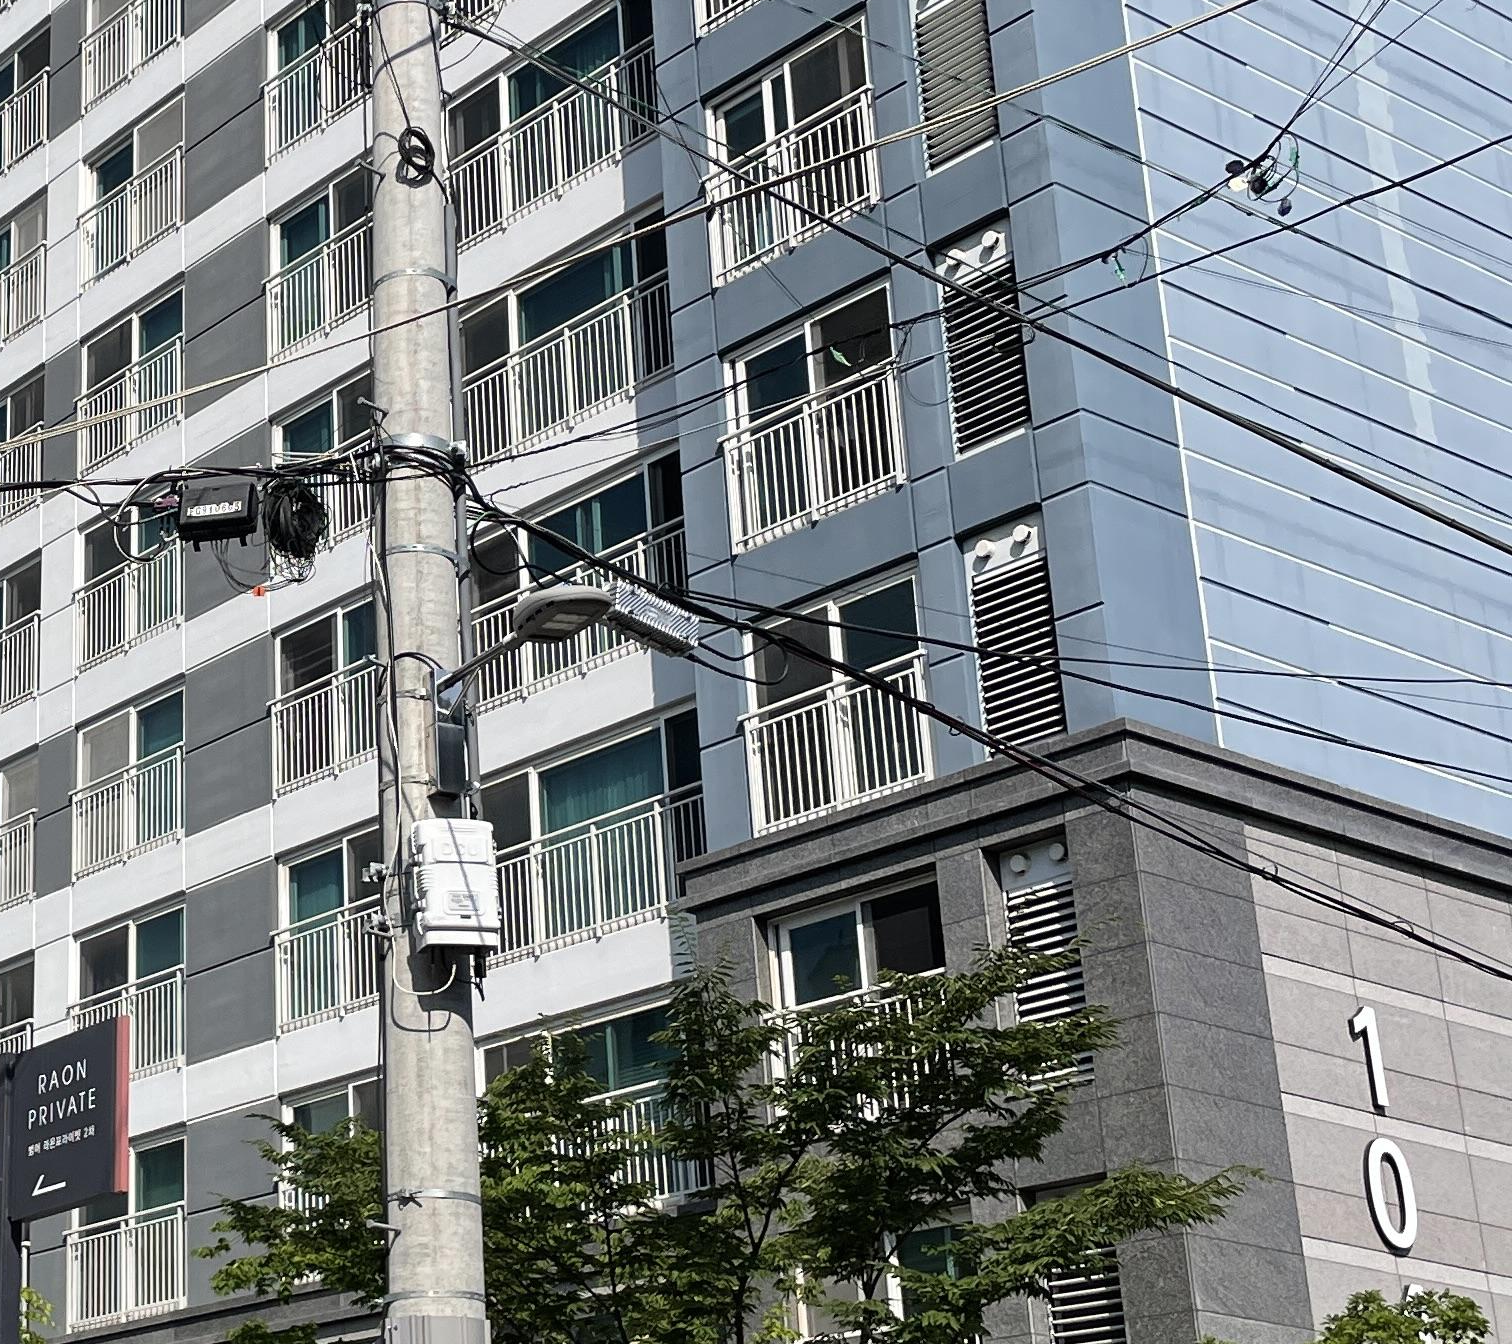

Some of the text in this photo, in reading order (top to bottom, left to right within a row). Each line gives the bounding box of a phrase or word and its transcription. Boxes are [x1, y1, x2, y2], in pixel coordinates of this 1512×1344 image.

[38, 1059, 87, 1095] RAON
[28, 1088, 96, 1130] PRIVATE
[1348, 1005, 1425, 1302] 10
